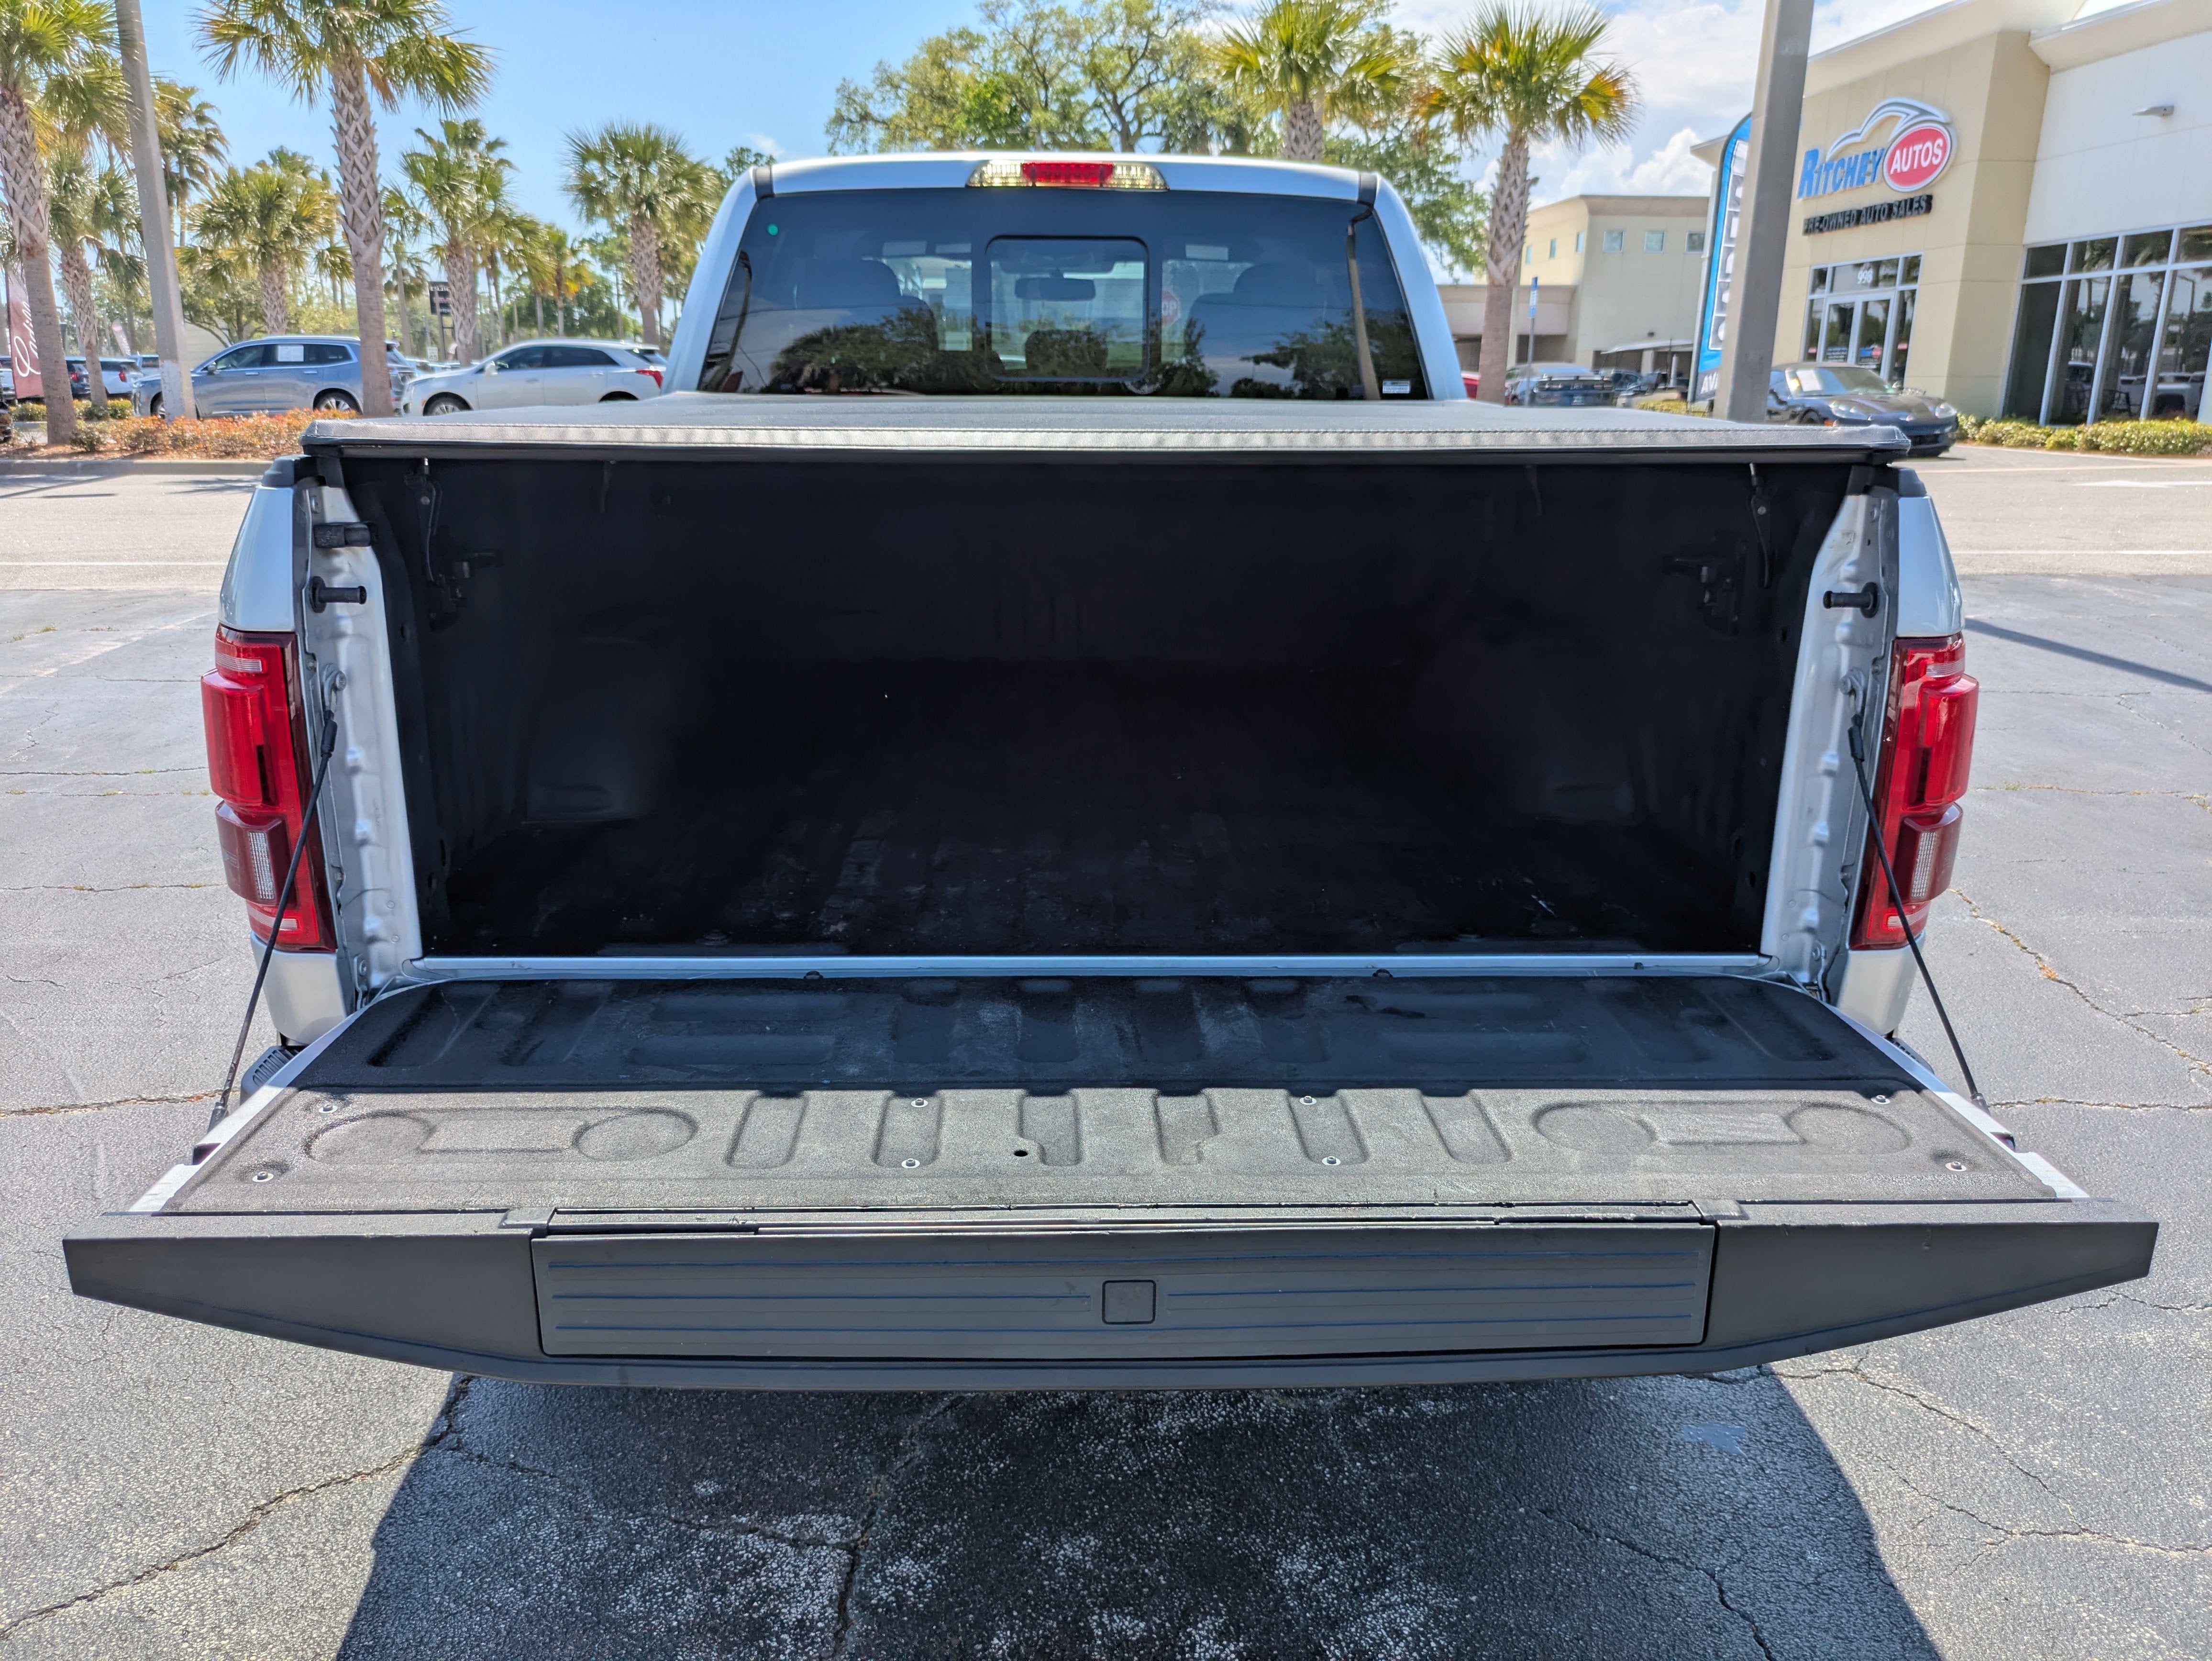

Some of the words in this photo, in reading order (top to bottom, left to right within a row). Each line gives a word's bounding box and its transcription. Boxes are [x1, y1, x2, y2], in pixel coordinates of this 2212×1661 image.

[1797, 147, 1885, 199] RITCHEY
[1891, 138, 1943, 175] AUTOS
[1803, 210, 1858, 235] PRE-OWNED
[1860, 202, 1890, 225] AUTO
[1891, 194, 1932, 219] SALES
[1161, 299, 1177, 316] OP
